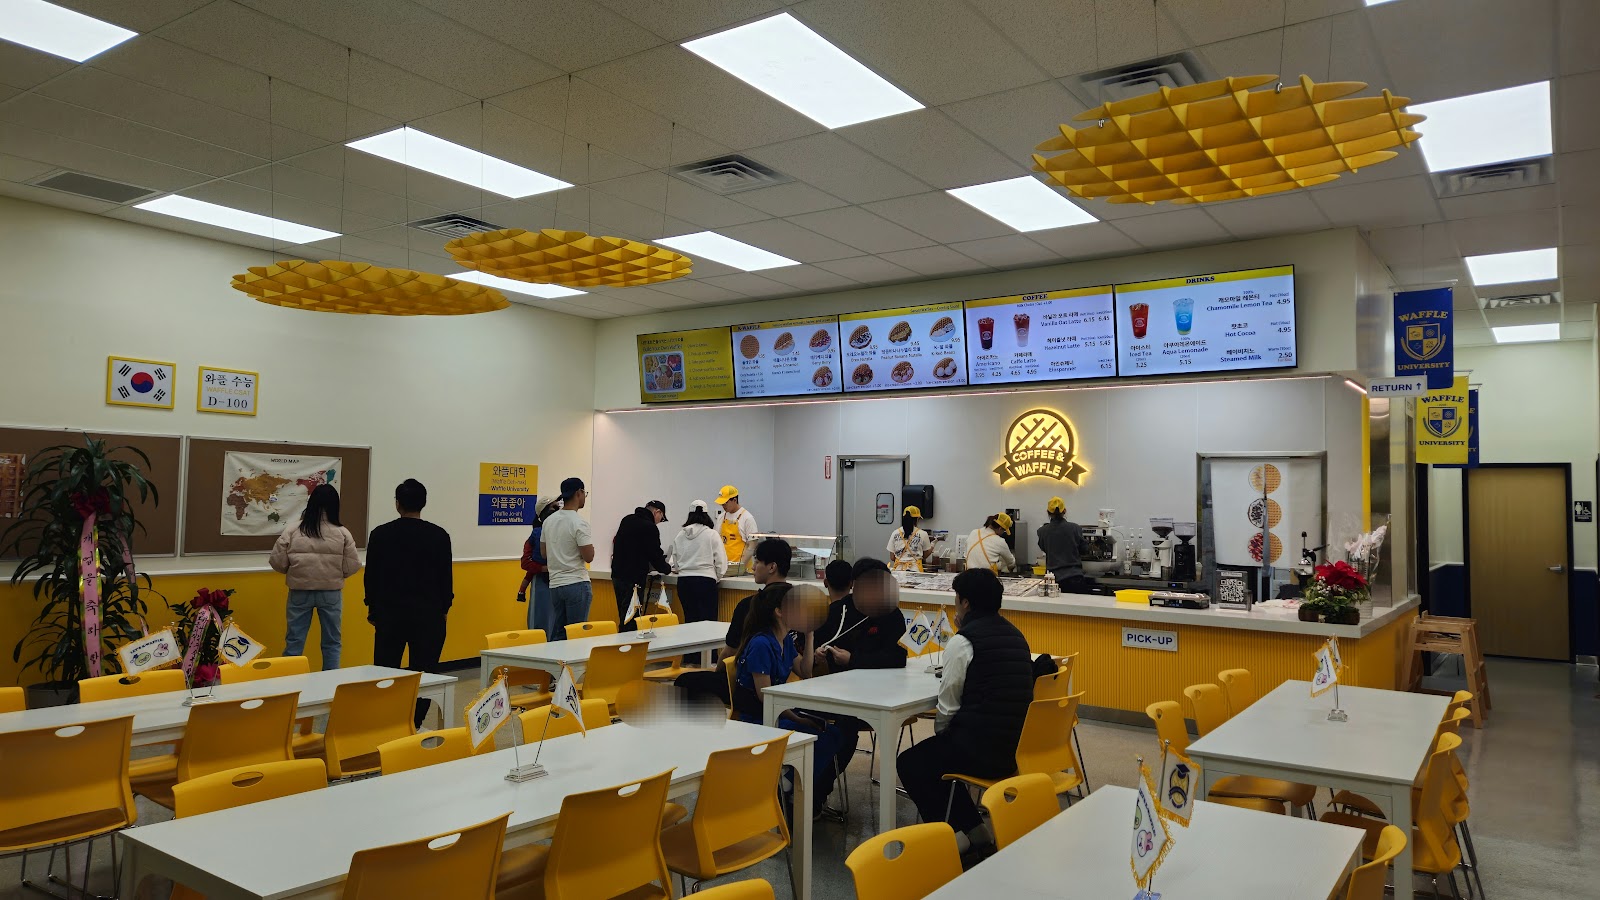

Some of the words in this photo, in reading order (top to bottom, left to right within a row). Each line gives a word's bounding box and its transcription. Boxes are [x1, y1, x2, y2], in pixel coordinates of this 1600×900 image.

[1186, 276, 1215, 284] DRINKS
[1207, 303, 1239, 312] Chamomile
[1398, 310, 1448, 322] WAFFLE
[1163, 348, 1177, 356] Aqua
[1220, 355, 1245, 363] Steamed
[1397, 362, 1450, 371] UNIVERSITY
[204, 373, 228, 386] 와플
[231, 376, 253, 388] 수능
[234, 388, 250, 396] CSAT
[1371, 384, 1413, 392] RETURN
[208, 396, 247, 408] D-100
[1421, 395, 1464, 404] WAFFLE
[1012, 449, 1055, 462] COFFEE
[1056, 452, 1065, 462] &
[493, 466, 526, 477] 와플대학
[1015, 462, 1062, 476] WAFFLE
[491, 497, 525, 509] 와플좋아
[1127, 634, 1172, 644] PICK-UP
